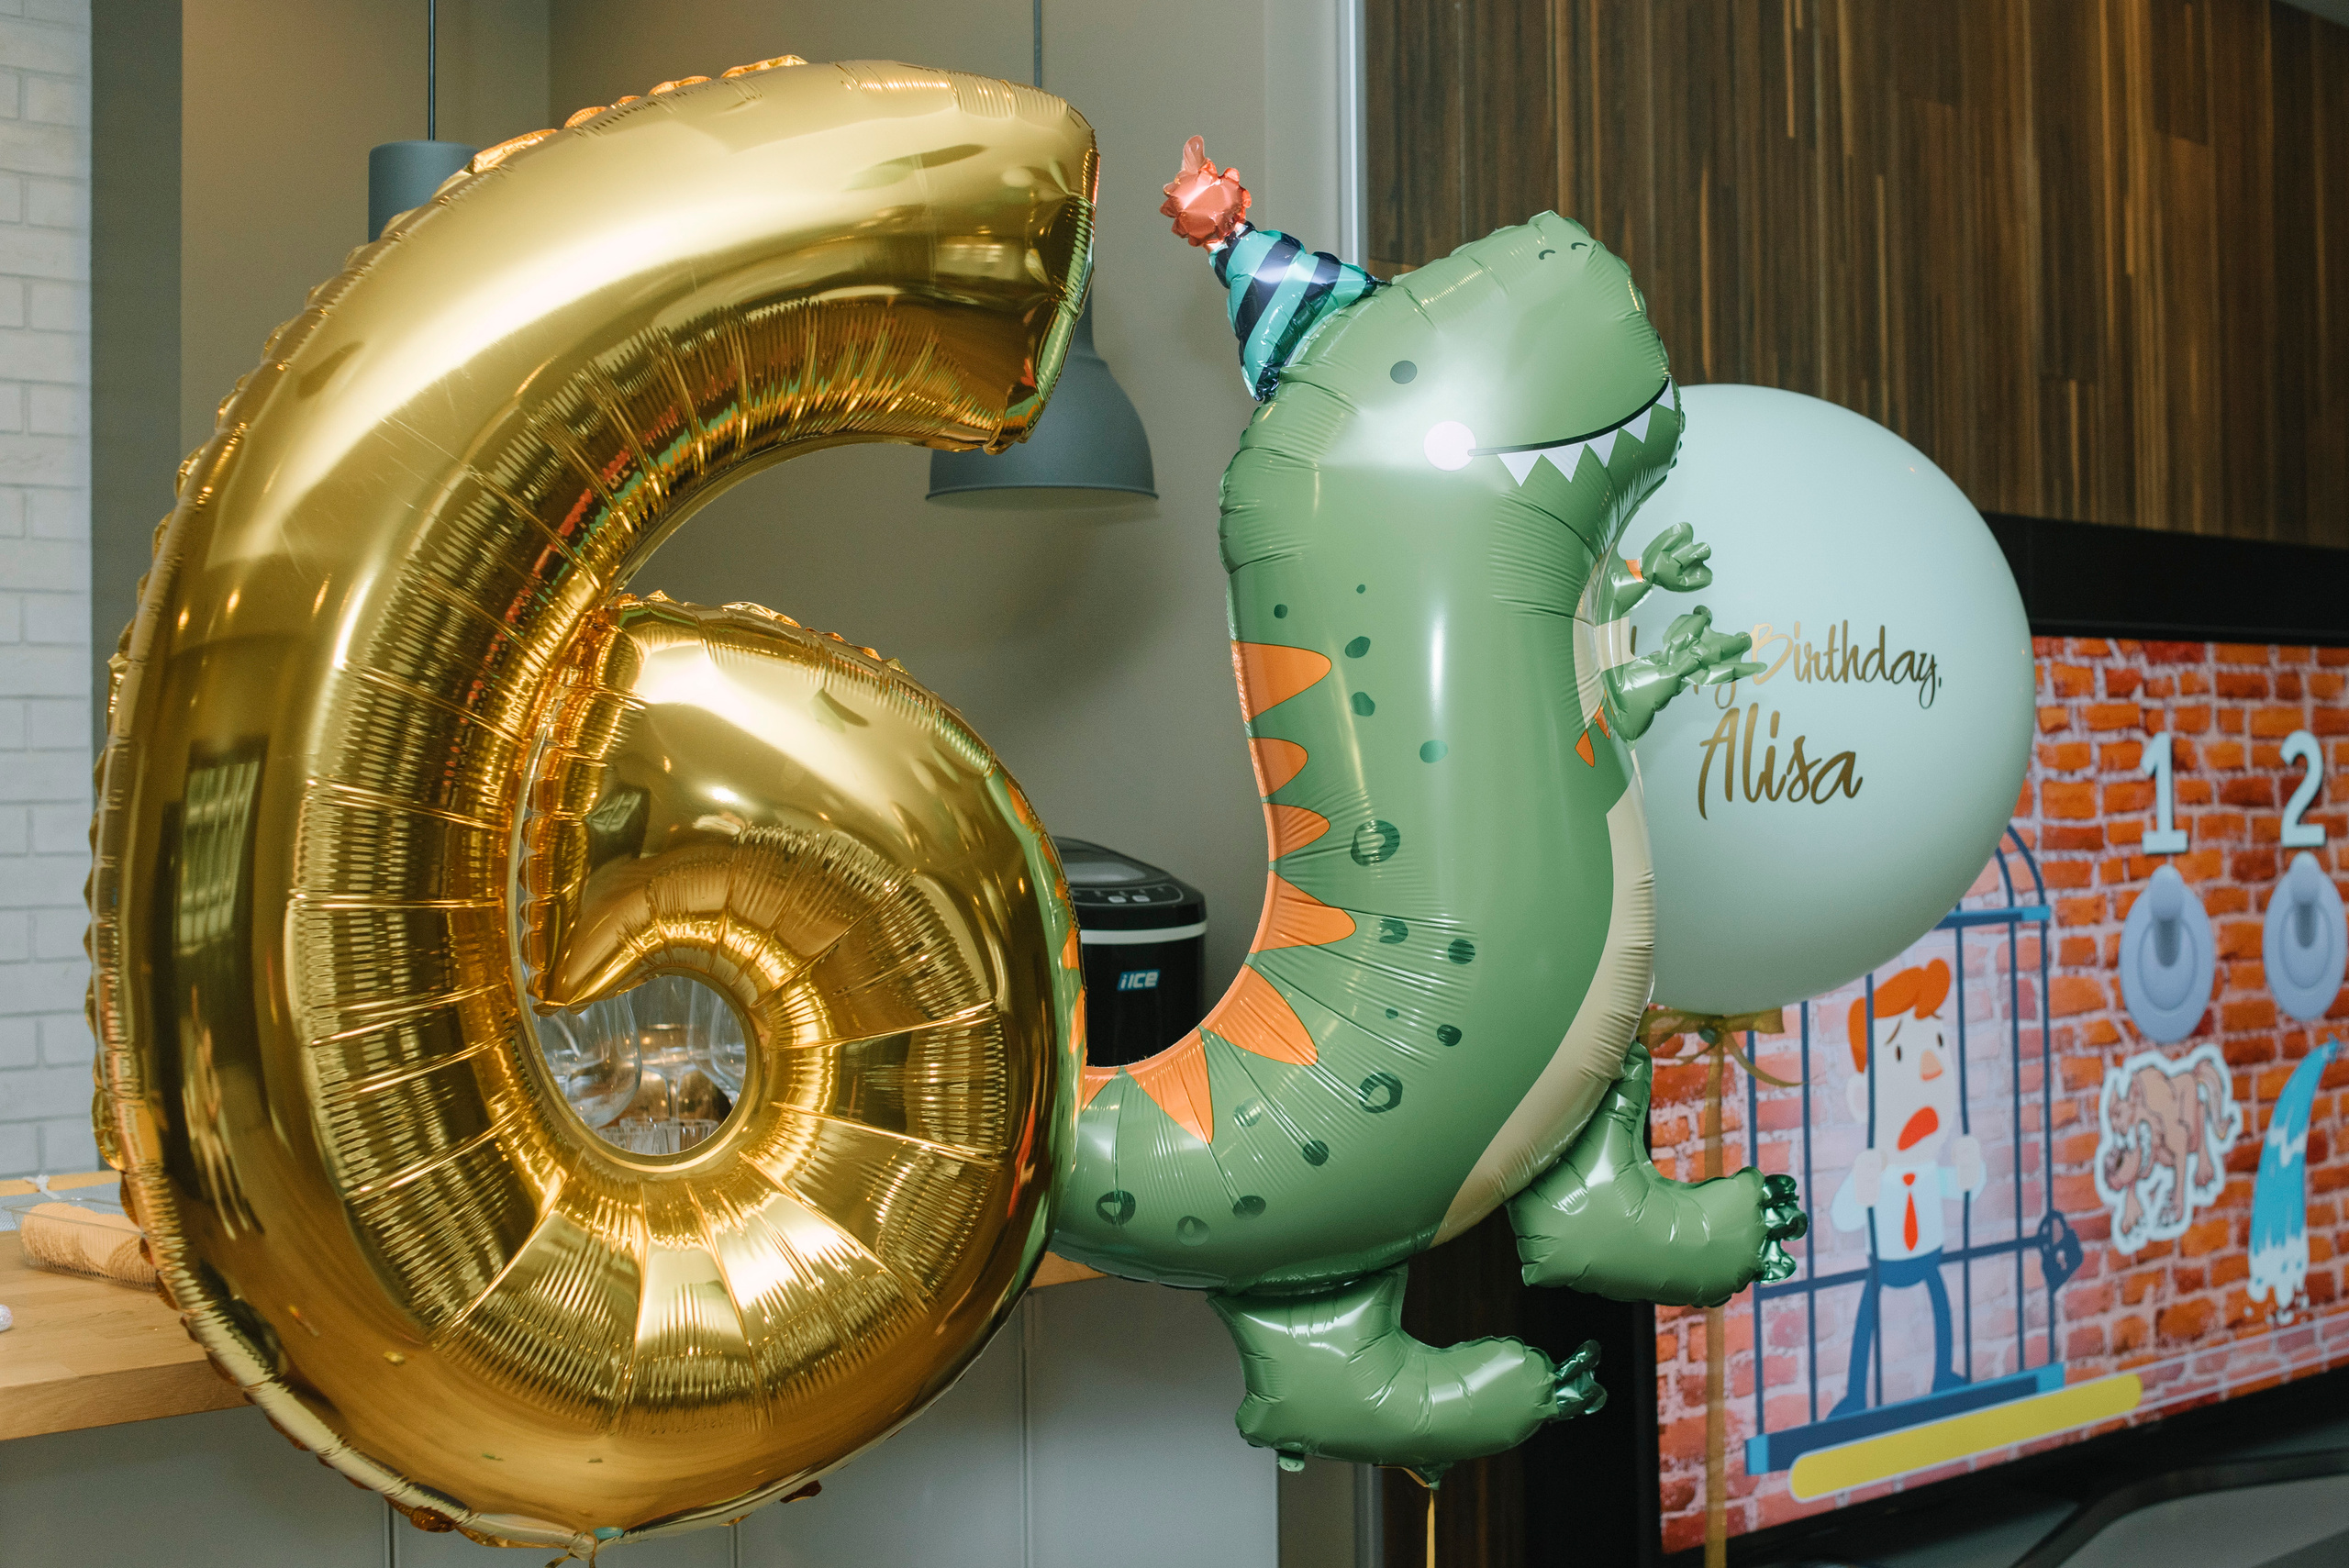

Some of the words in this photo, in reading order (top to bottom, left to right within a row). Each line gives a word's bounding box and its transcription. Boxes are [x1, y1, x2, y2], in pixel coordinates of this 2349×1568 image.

[1749, 619, 1943, 710] Birthday,
[1698, 702, 1864, 820] Alisa
[2140, 731, 2188, 854] 1
[2279, 729, 2326, 848] 2
